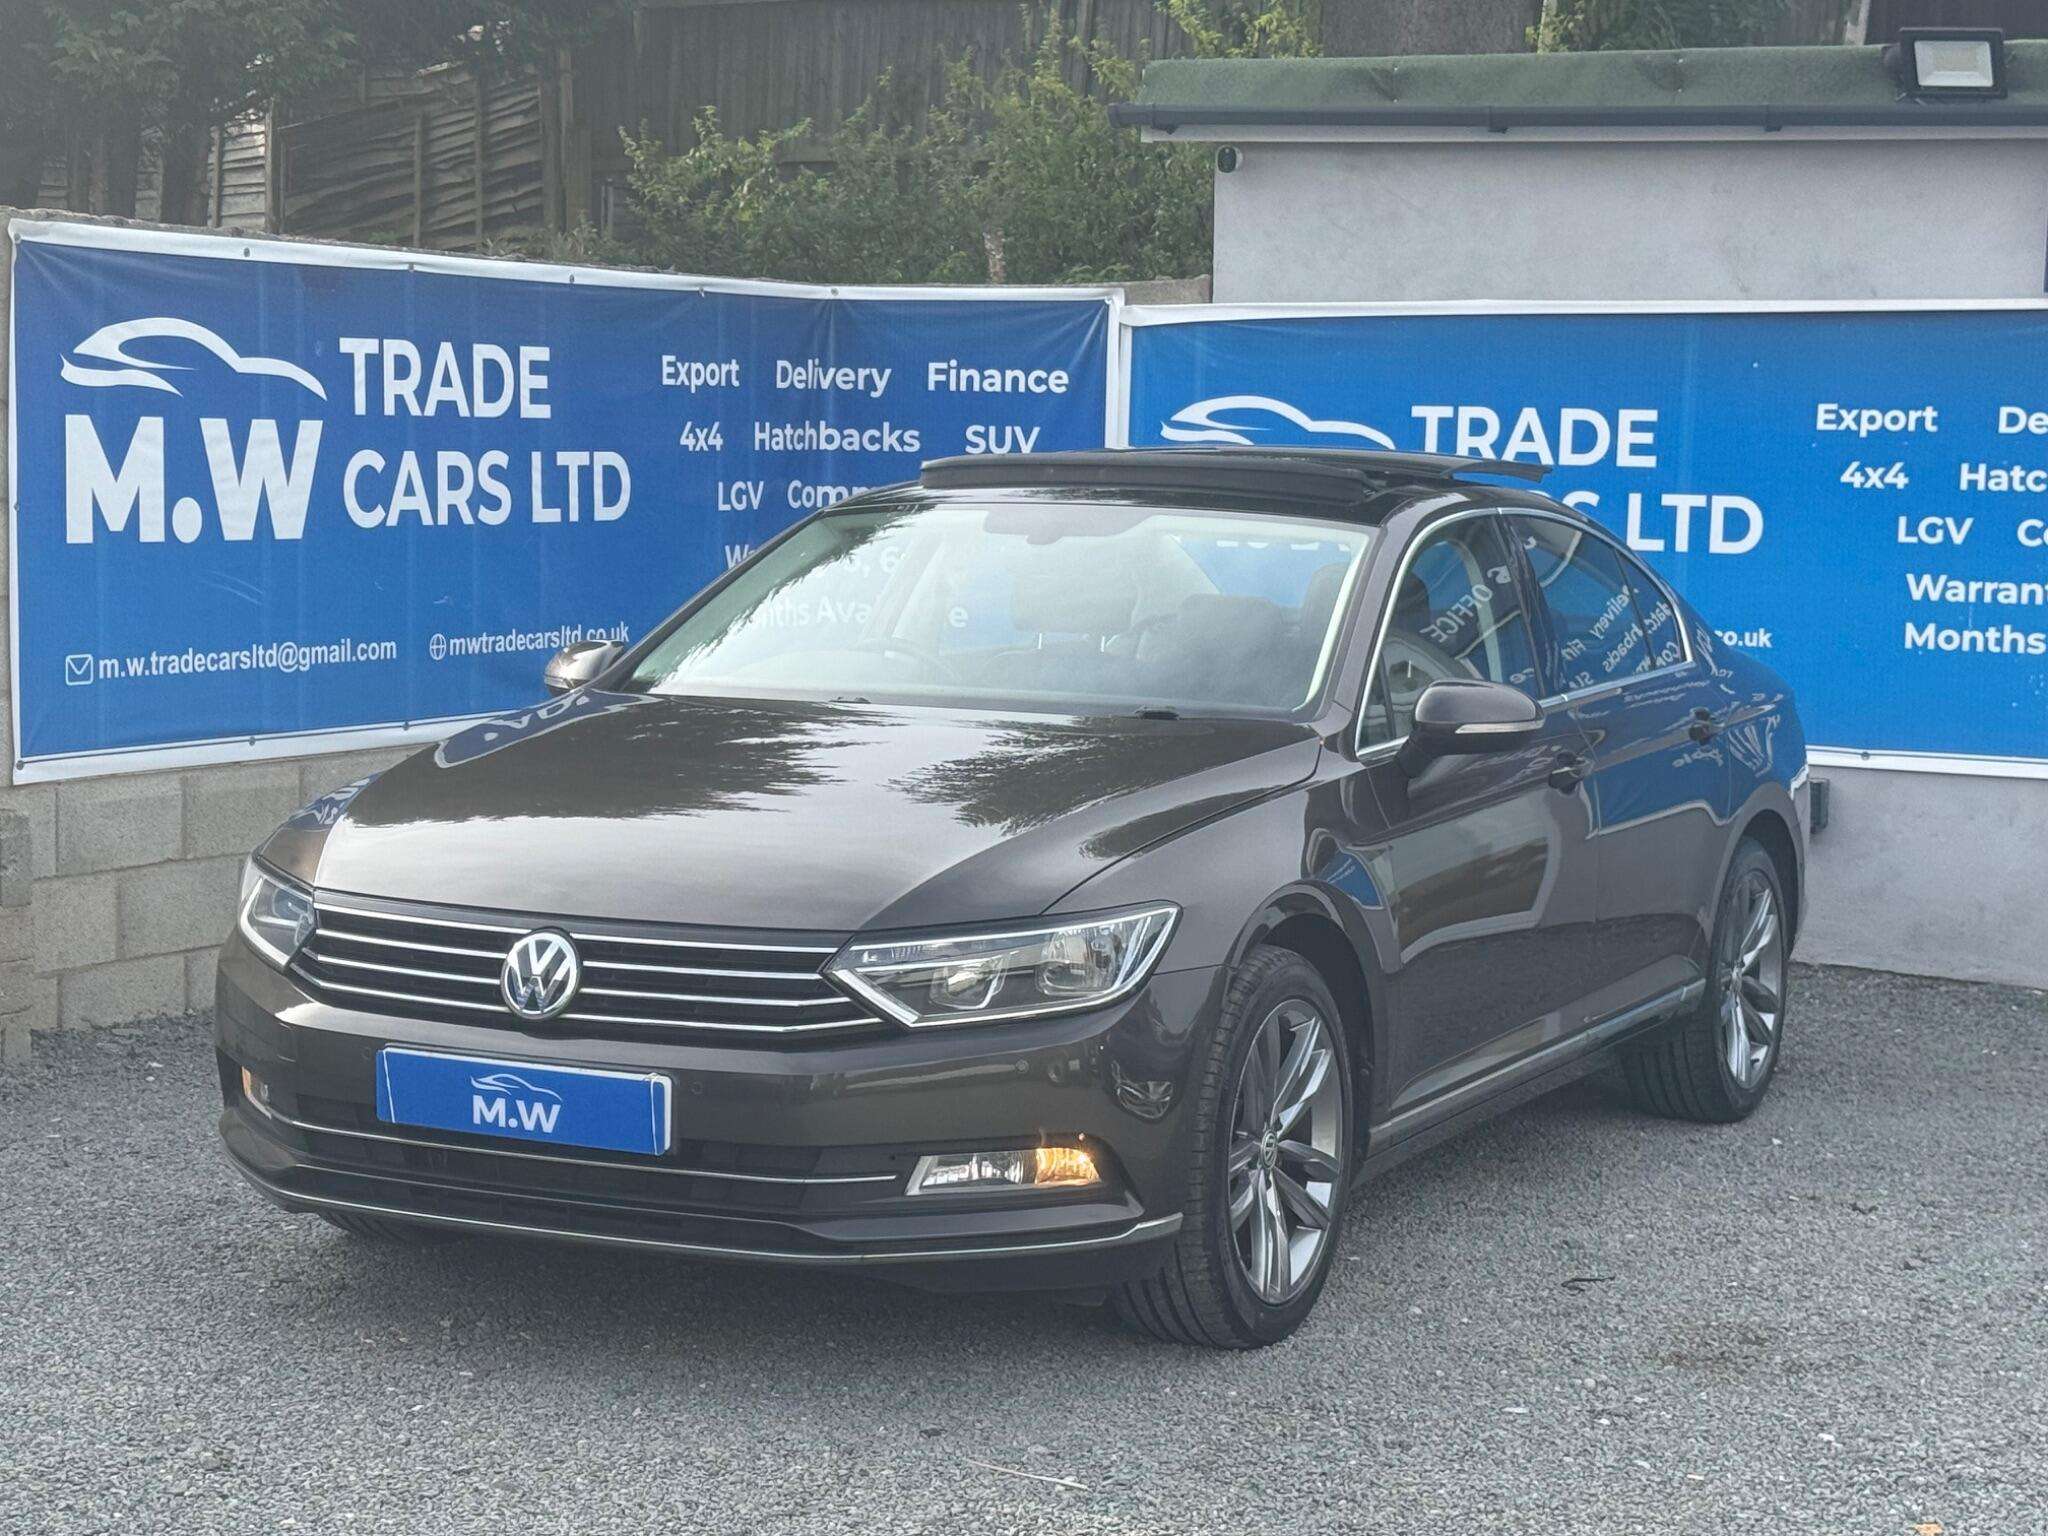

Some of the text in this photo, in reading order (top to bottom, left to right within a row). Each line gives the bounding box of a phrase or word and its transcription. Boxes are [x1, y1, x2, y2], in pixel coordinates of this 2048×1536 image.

[339, 337, 552, 419] TRADE
[661, 354, 1069, 398] Export Delivery Finance
[679, 420, 1041, 454] 4x4 Hatchbacks SUV
[1411, 405, 1658, 467] TRADE
[1816, 403, 1938, 438] Export
[65, 414, 324, 544] M.W
[343, 449, 631, 529] CARS LTD
[1840, 461, 1909, 489] 4x4
[718, 479, 882, 511] LGV Com
[1624, 492, 1764, 555] LTD
[1897, 515, 1974, 545] LGV
[1906, 573, 2048, 605] Warran
[449, 621, 630, 657] mwtradecarsltdcouk
[1904, 622, 2047, 655] Months
[98, 638, 397, 681] m.w.tradecarsltd@gmail.com
[472, 1094, 561, 1134] M.W
